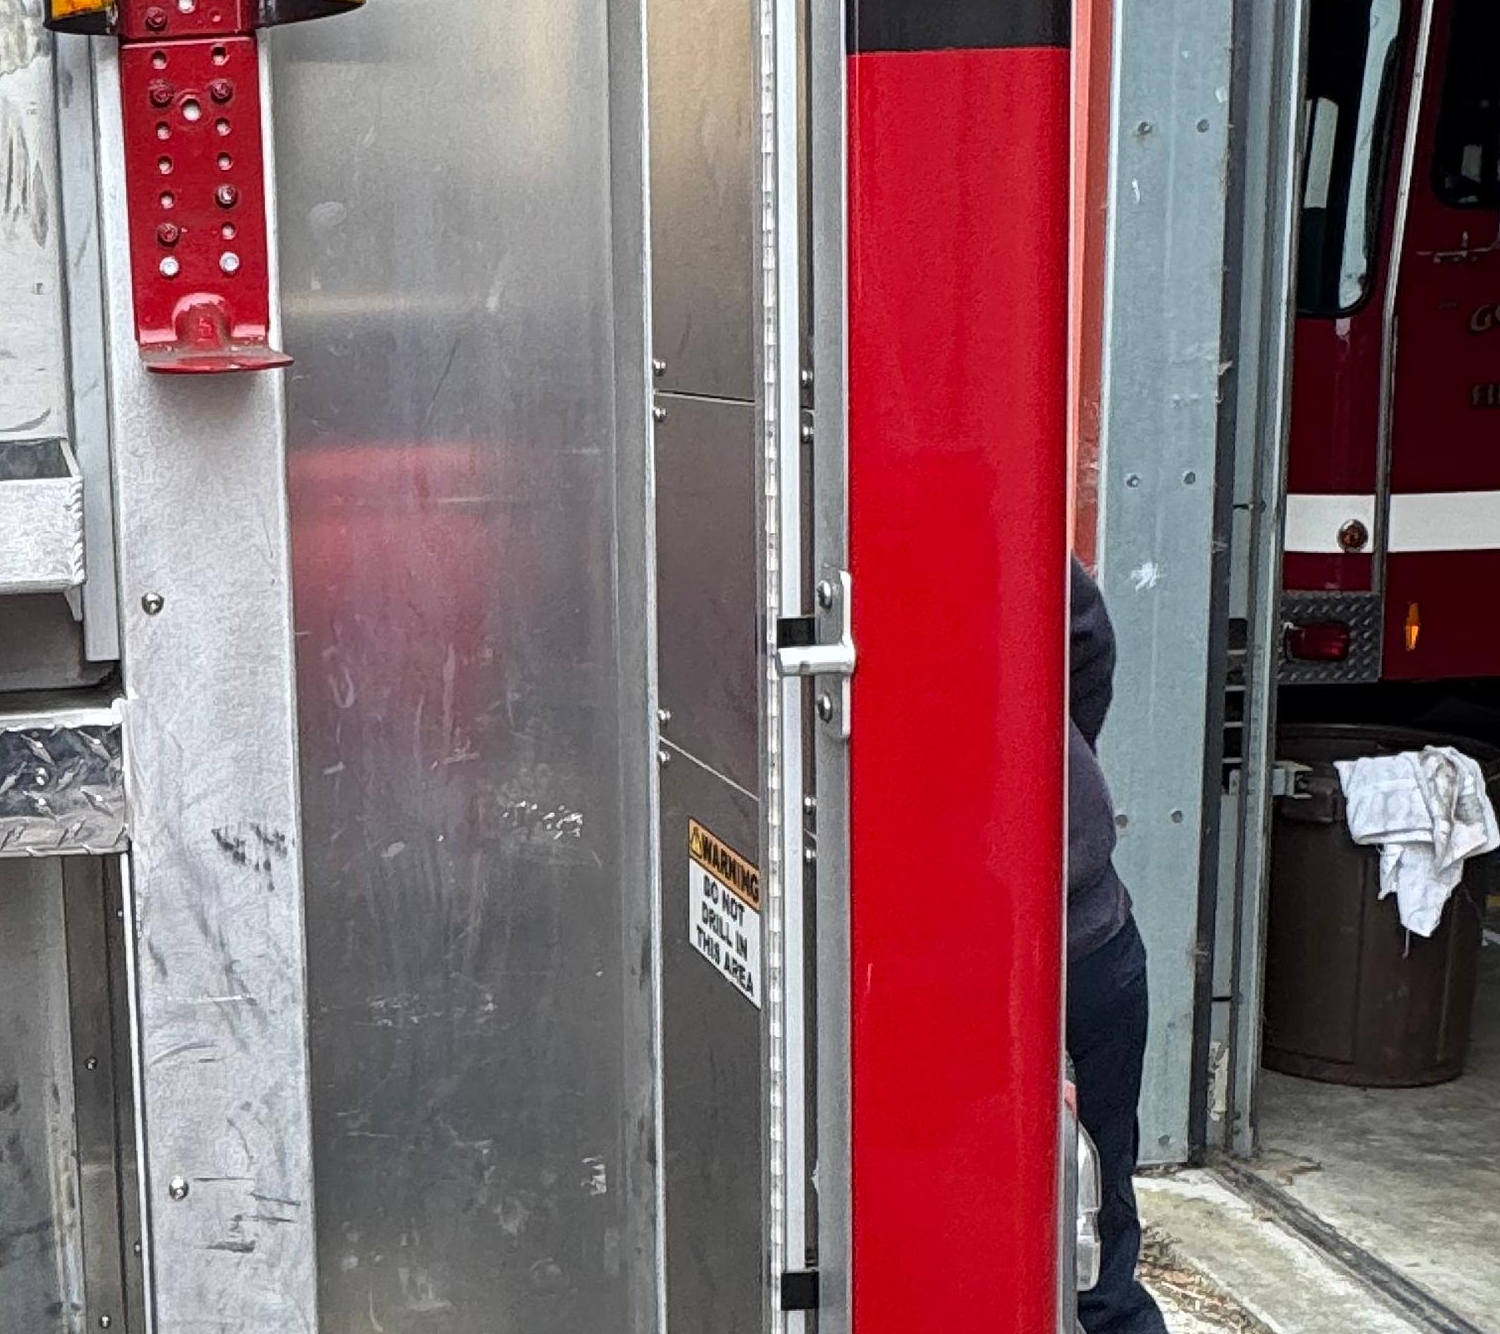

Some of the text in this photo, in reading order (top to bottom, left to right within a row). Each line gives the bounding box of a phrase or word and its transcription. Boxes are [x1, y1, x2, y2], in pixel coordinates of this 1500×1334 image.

[701, 832, 759, 903] WARNING
[703, 874, 745, 927] DO NOT
[696, 924, 754, 997] THIS AREA
[701, 900, 748, 962] DRILL IN
